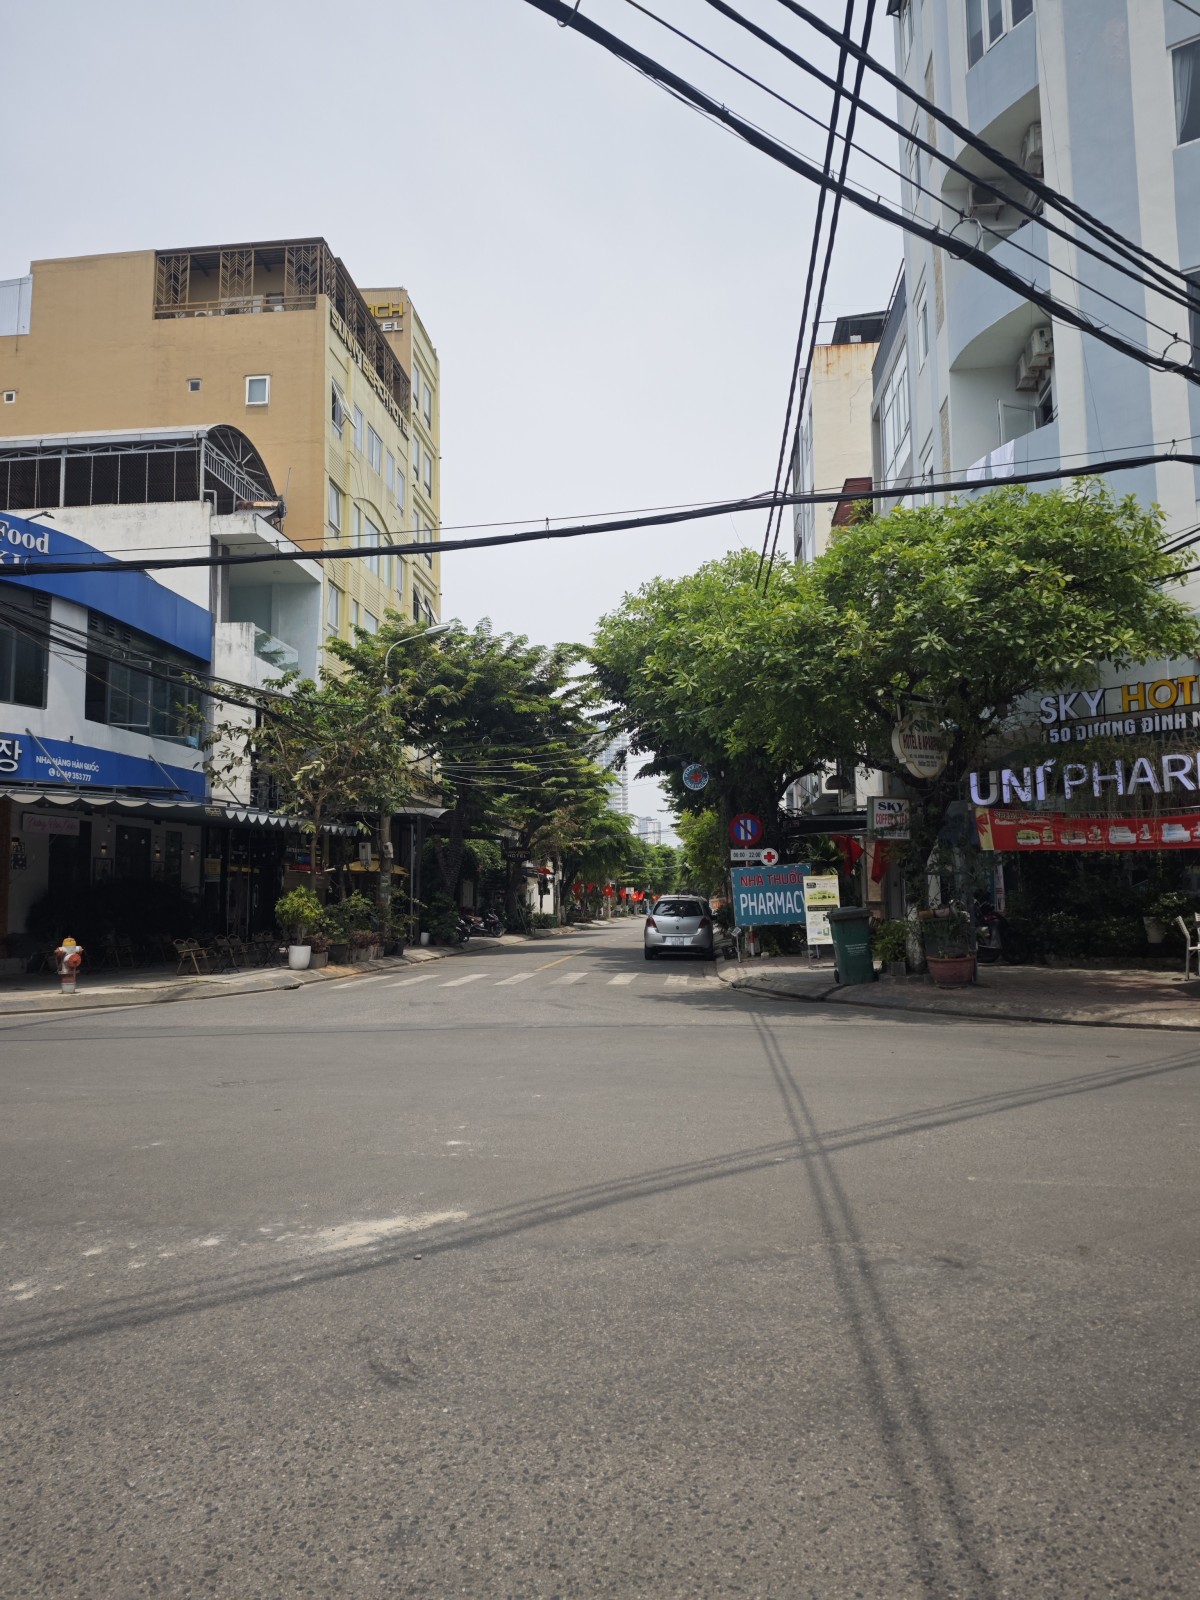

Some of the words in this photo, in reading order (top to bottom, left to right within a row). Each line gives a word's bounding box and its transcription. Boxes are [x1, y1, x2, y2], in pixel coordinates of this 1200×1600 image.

[1040, 688, 1104, 725] SKY
[1121, 674, 1200, 713] HOT
[1142, 711, 1187, 733] ĐÌNH
[1063, 752, 1200, 800] PHAR
[878, 801, 905, 811] SKY
[739, 873, 765, 887] NHÀ
